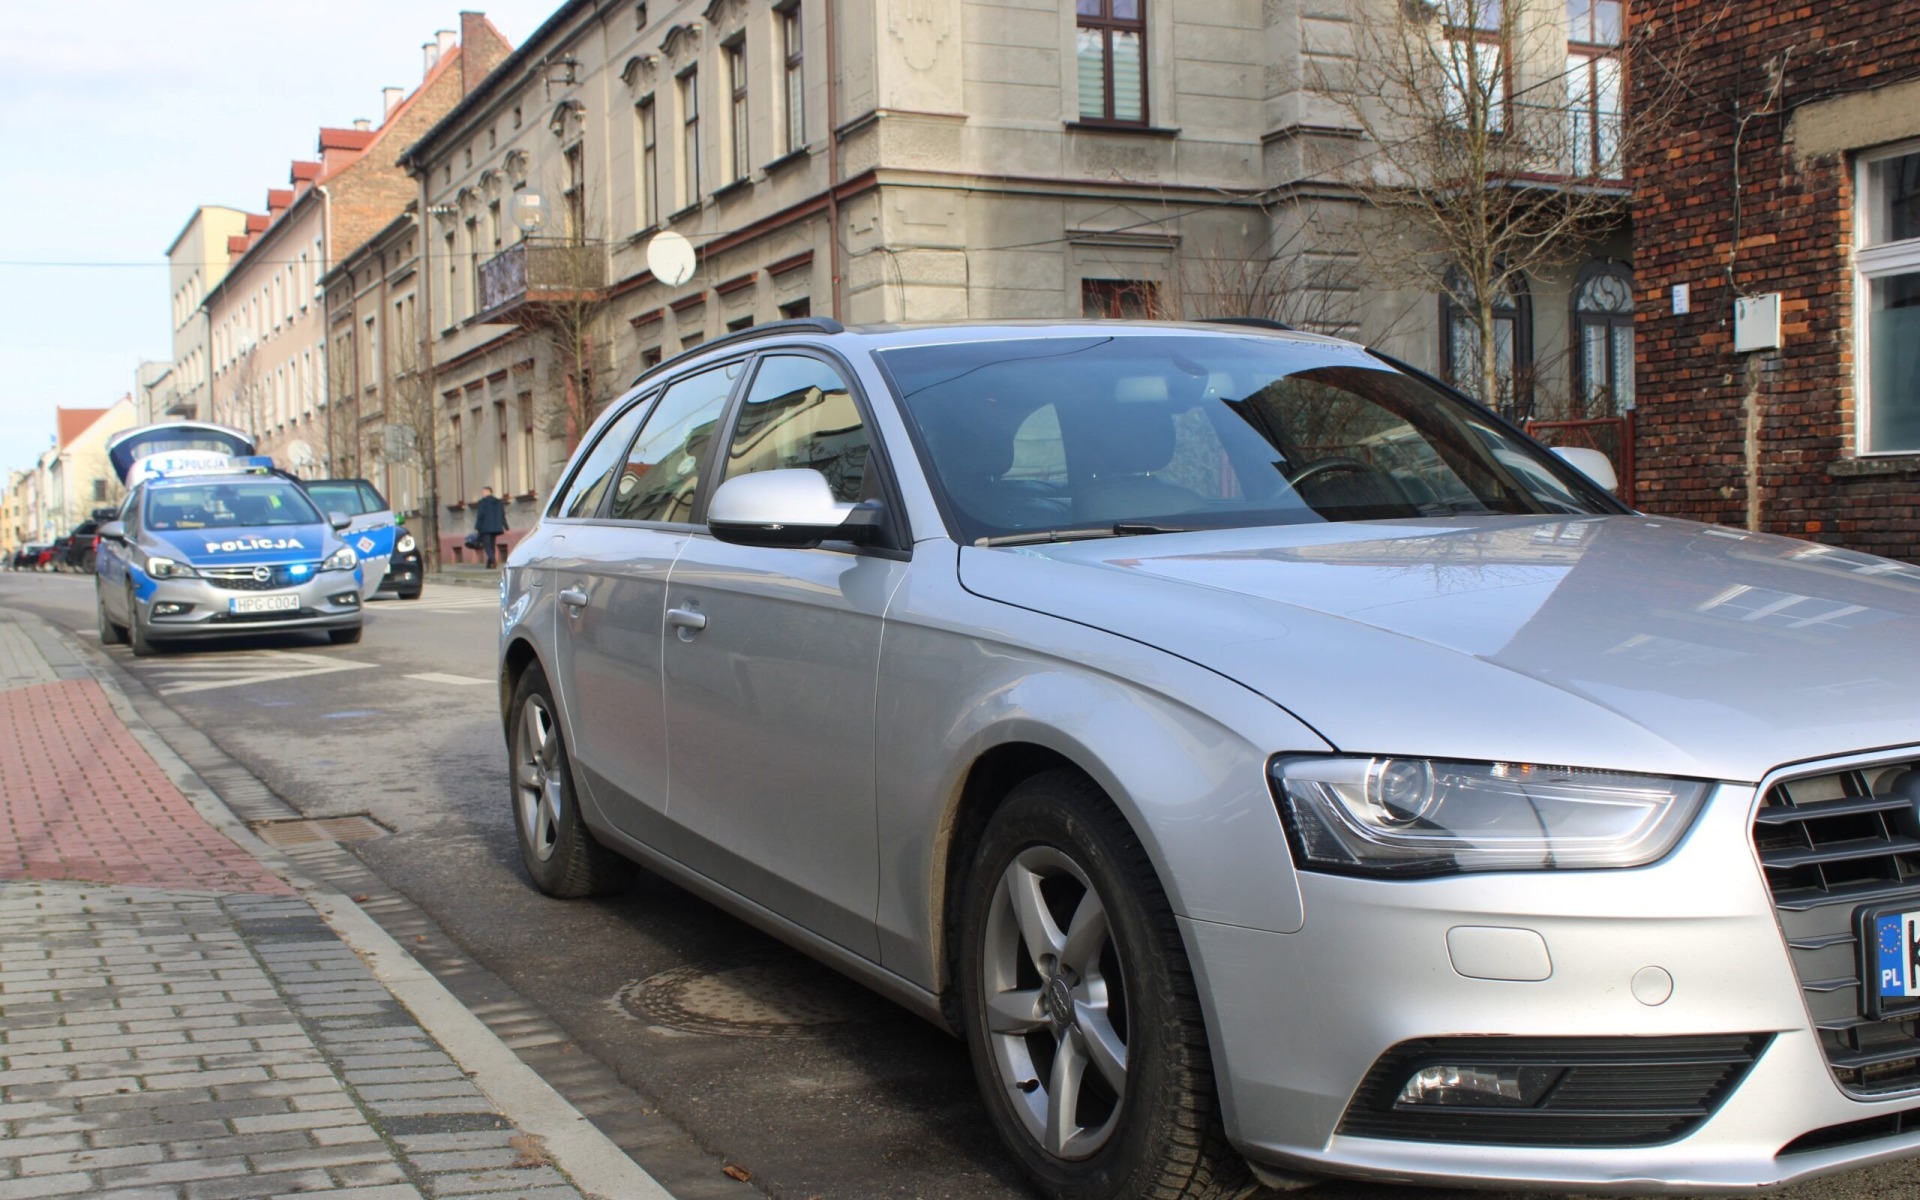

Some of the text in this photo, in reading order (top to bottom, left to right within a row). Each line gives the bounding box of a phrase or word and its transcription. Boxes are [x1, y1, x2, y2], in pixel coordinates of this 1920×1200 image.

[184, 459, 225, 470] POLICJA
[205, 538, 304, 553] POLICJA
[238, 596, 297, 611] HPG C004
[1881, 968, 1902, 988] PL
